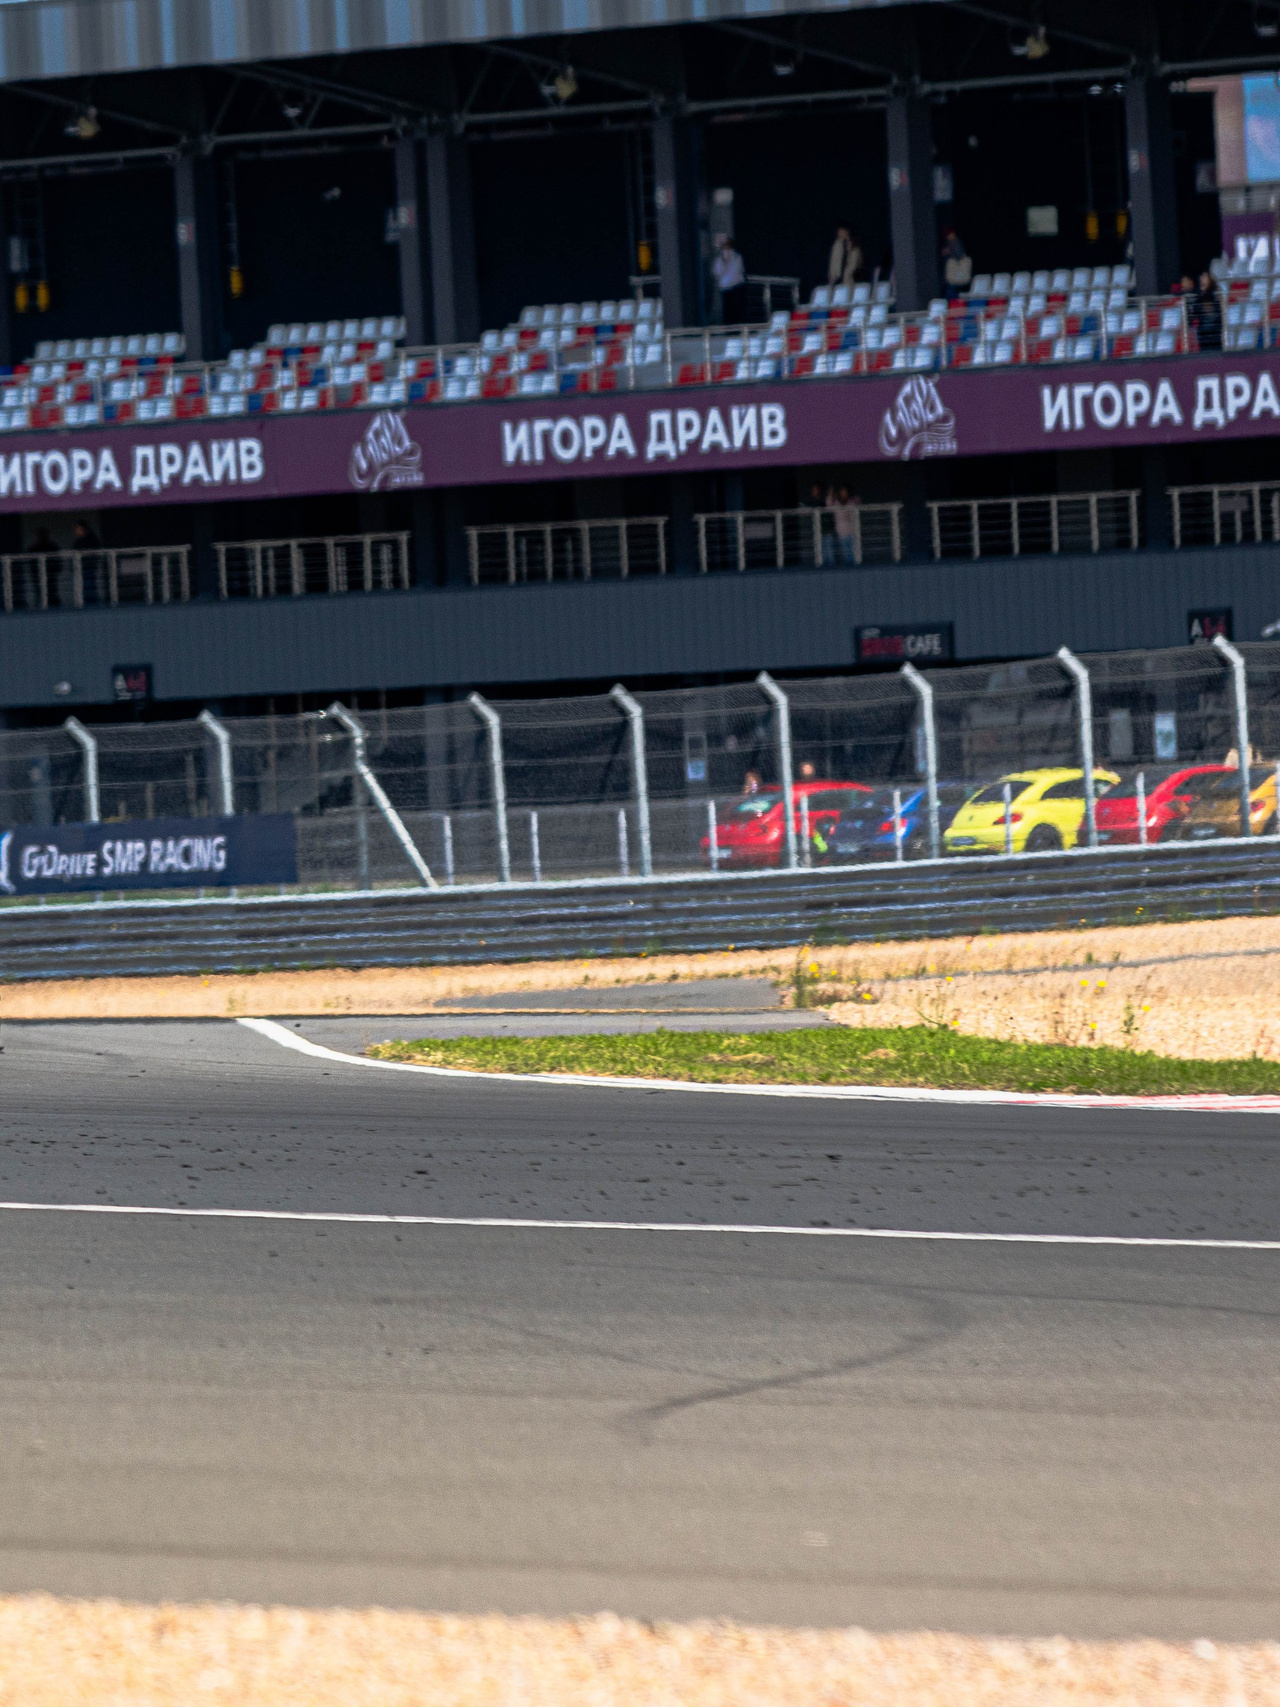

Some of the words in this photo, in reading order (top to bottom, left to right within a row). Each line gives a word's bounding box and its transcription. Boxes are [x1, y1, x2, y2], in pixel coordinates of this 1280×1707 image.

[1042, 378, 1183, 432] ИГОРА
[1193, 372, 1280, 430] ДРА
[503, 413, 636, 463] ИГОРА
[646, 403, 787, 461] ДРАЙВ
[130, 438, 264, 495] ДРАЙВ
[906, 634, 942, 657] CAFE
[102, 840, 147, 875] SMP
[149, 836, 226, 872] RACING
